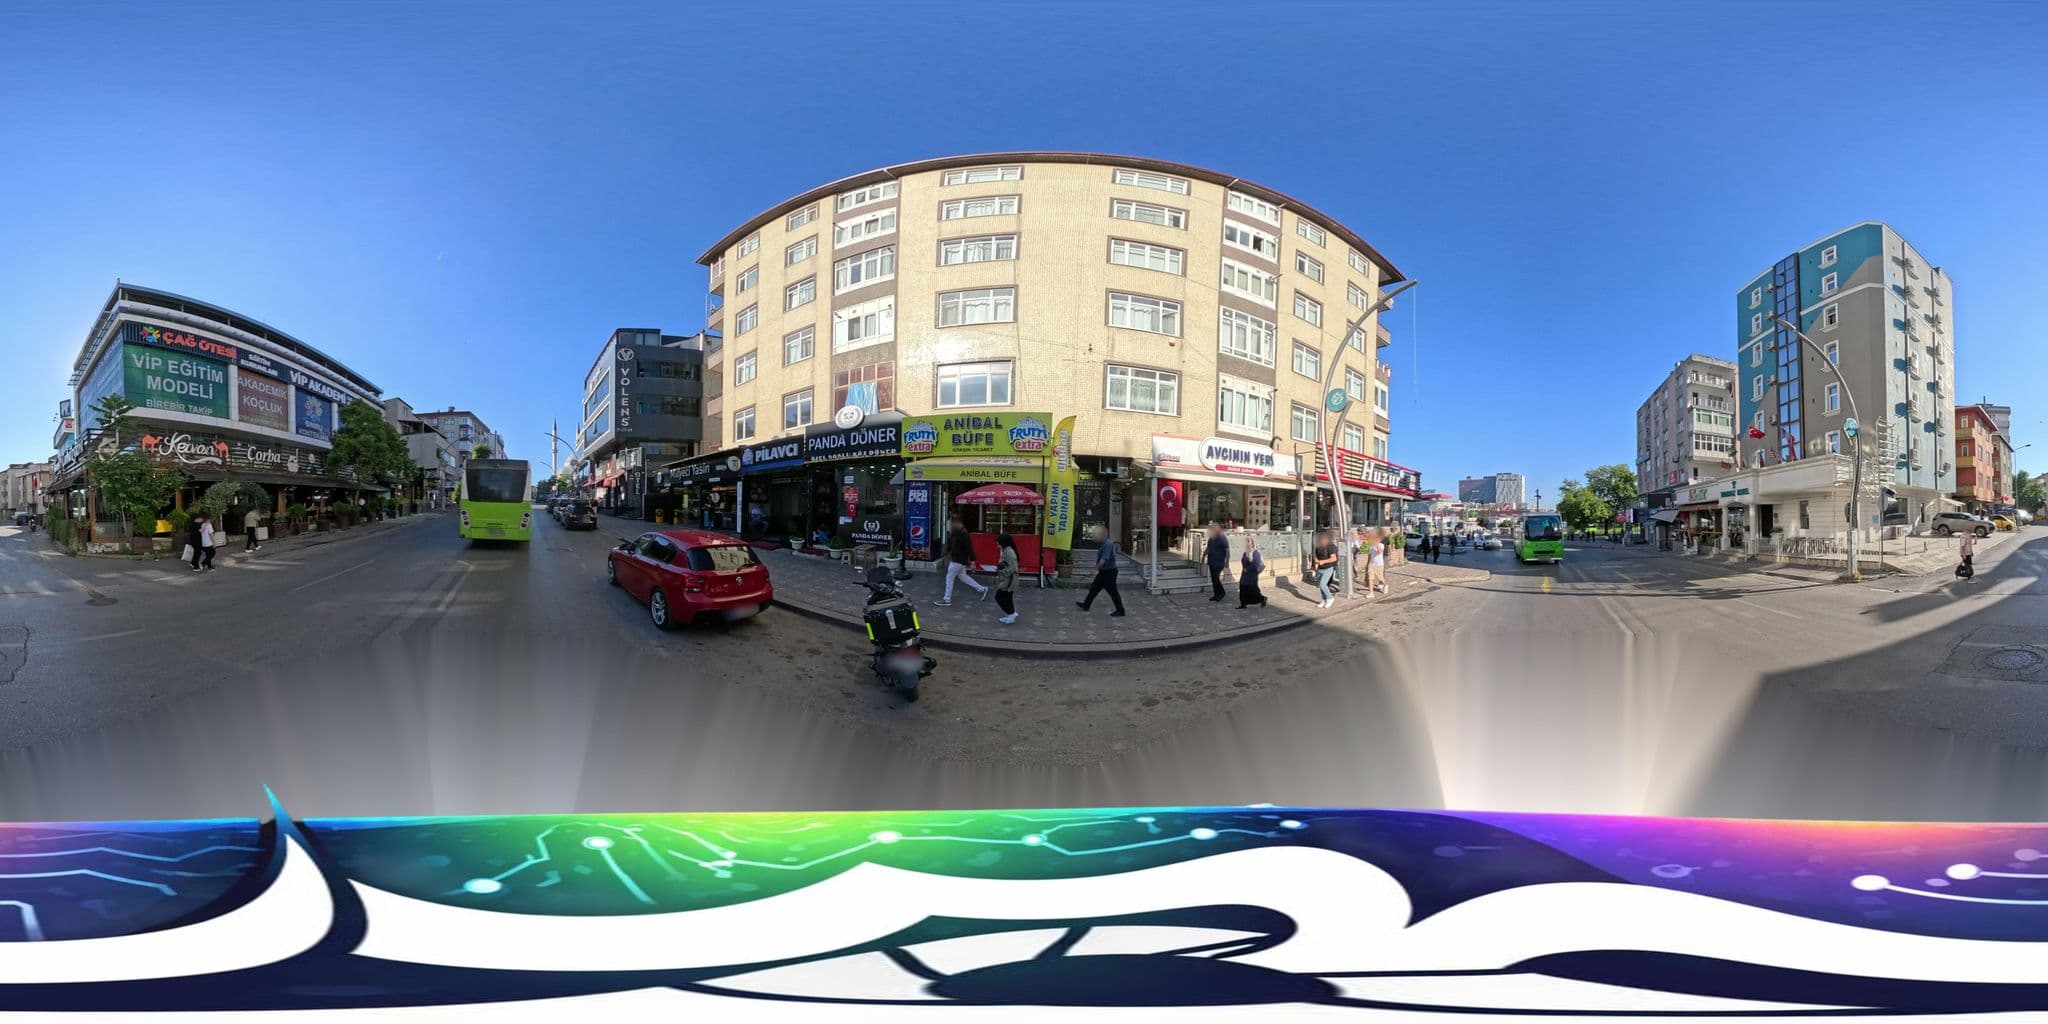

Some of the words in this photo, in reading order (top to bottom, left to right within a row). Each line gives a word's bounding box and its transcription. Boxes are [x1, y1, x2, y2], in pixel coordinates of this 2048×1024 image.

[162, 331, 196, 348] ÇAĞ
[132, 352, 162, 370] VİP
[168, 359, 223, 384] EĞİTİM
[290, 370, 309, 387] VİP
[147, 375, 213, 400] MODELİ
[146, 399, 186, 412] BİREBİR
[187, 405, 213, 416] TAKİP
[243, 395, 284, 415] KOÇLUK
[943, 414, 1003, 431] ANİBAL
[808, 434, 847, 451] PANDA
[850, 427, 896, 446] DÖNER
[908, 441, 932, 452] extra
[951, 431, 994, 446] BÜFE
[1015, 440, 1042, 450] extra
[755, 443, 798, 462] PİLAVCI
[1206, 445, 1251, 465] AVCININ
[691, 462, 710, 476] Yasin
[960, 469, 991, 478] ANİBAL
[994, 470, 1017, 478] BÜFE
[1360, 459, 1401, 488] Huzur
[1050, 482, 1060, 518] YAPIMI
[1058, 488, 1070, 532] TADINDA
[852, 532, 871, 540] PANDA
[1048, 522, 1056, 536] EV
